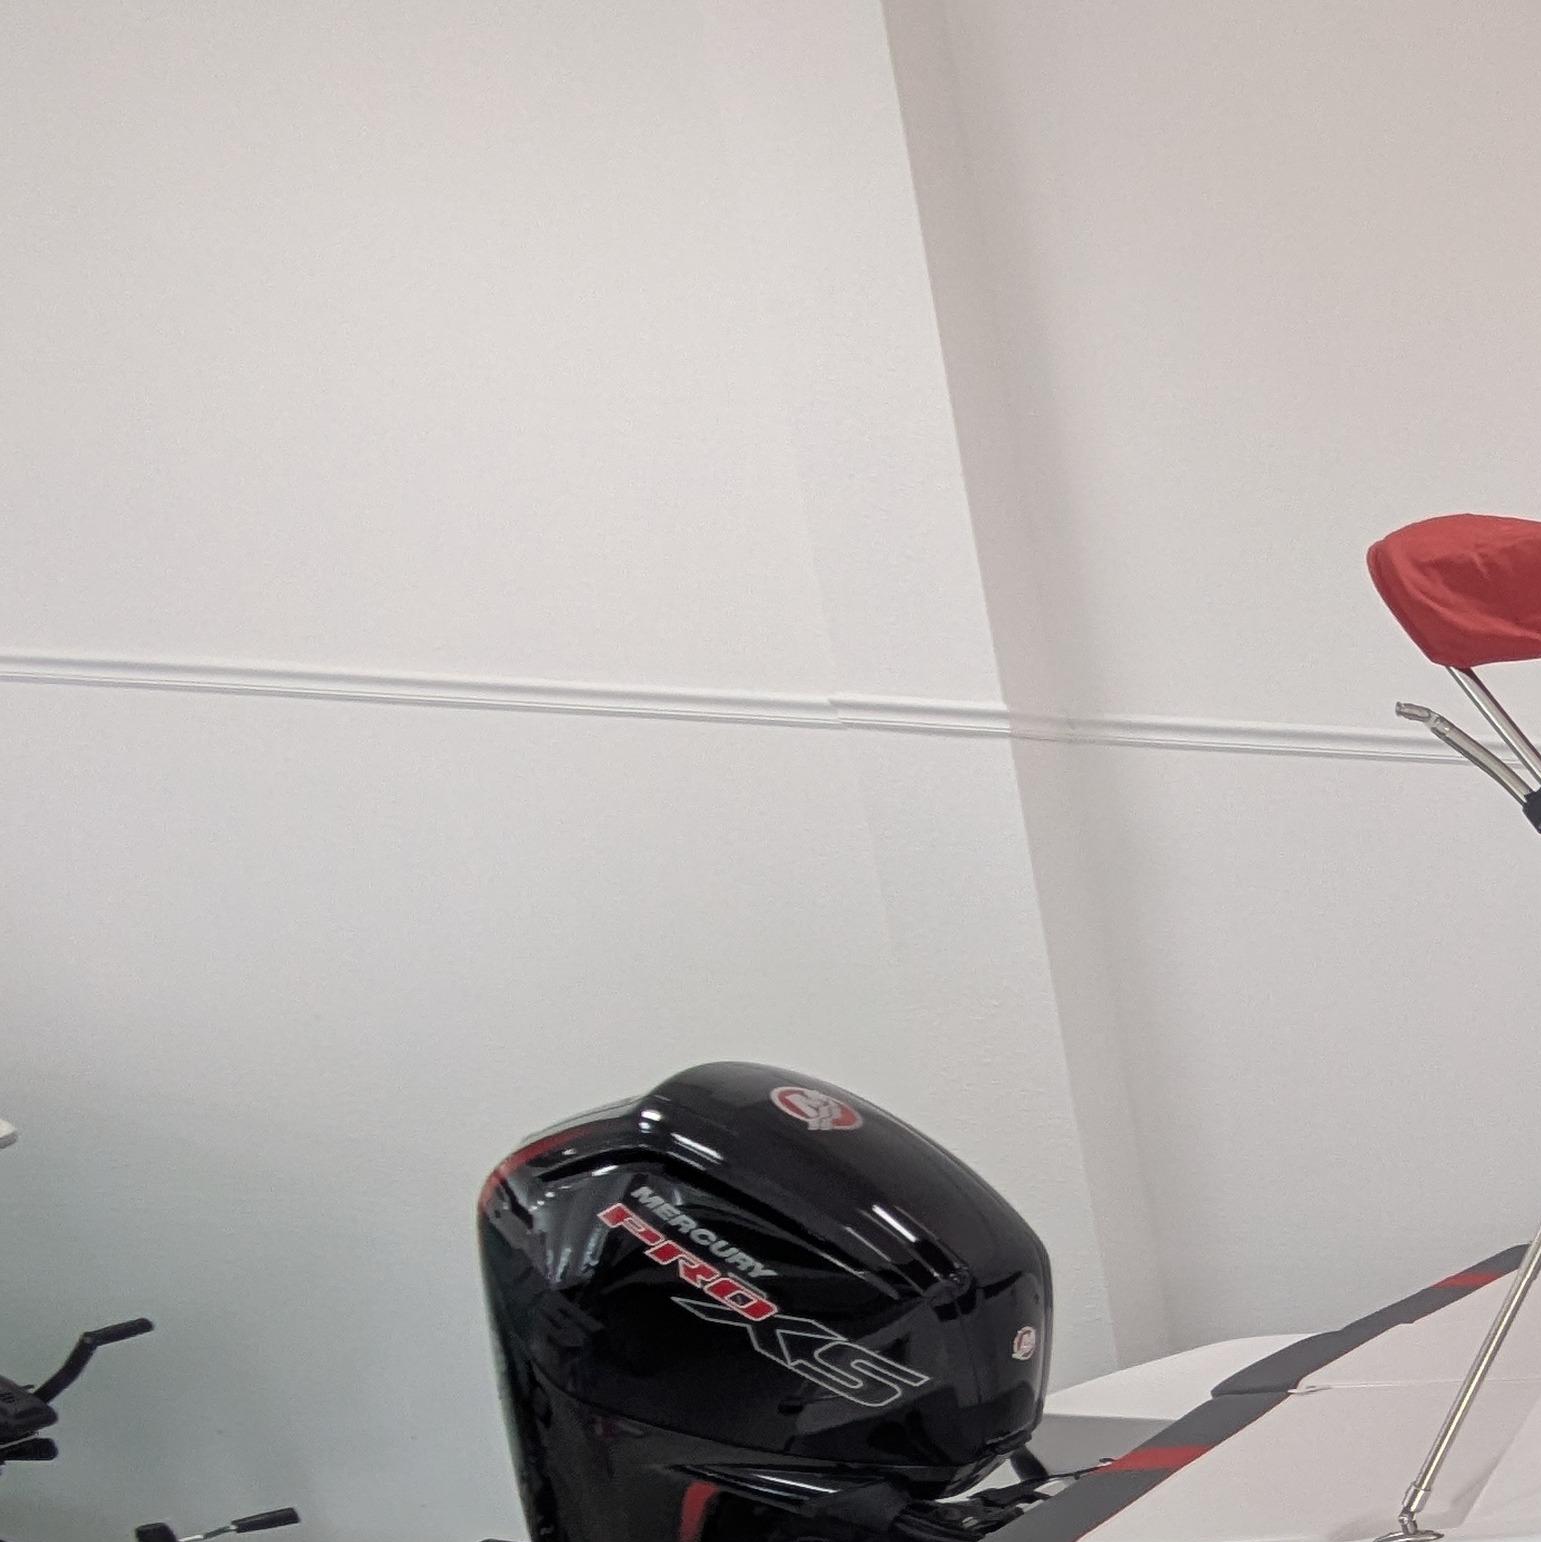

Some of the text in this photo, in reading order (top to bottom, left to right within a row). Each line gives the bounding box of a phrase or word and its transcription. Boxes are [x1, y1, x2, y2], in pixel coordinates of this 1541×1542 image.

[597, 1202, 779, 1322] PRO
[630, 1185, 779, 1278] MERCURY
[669, 1295, 931, 1407] XS
